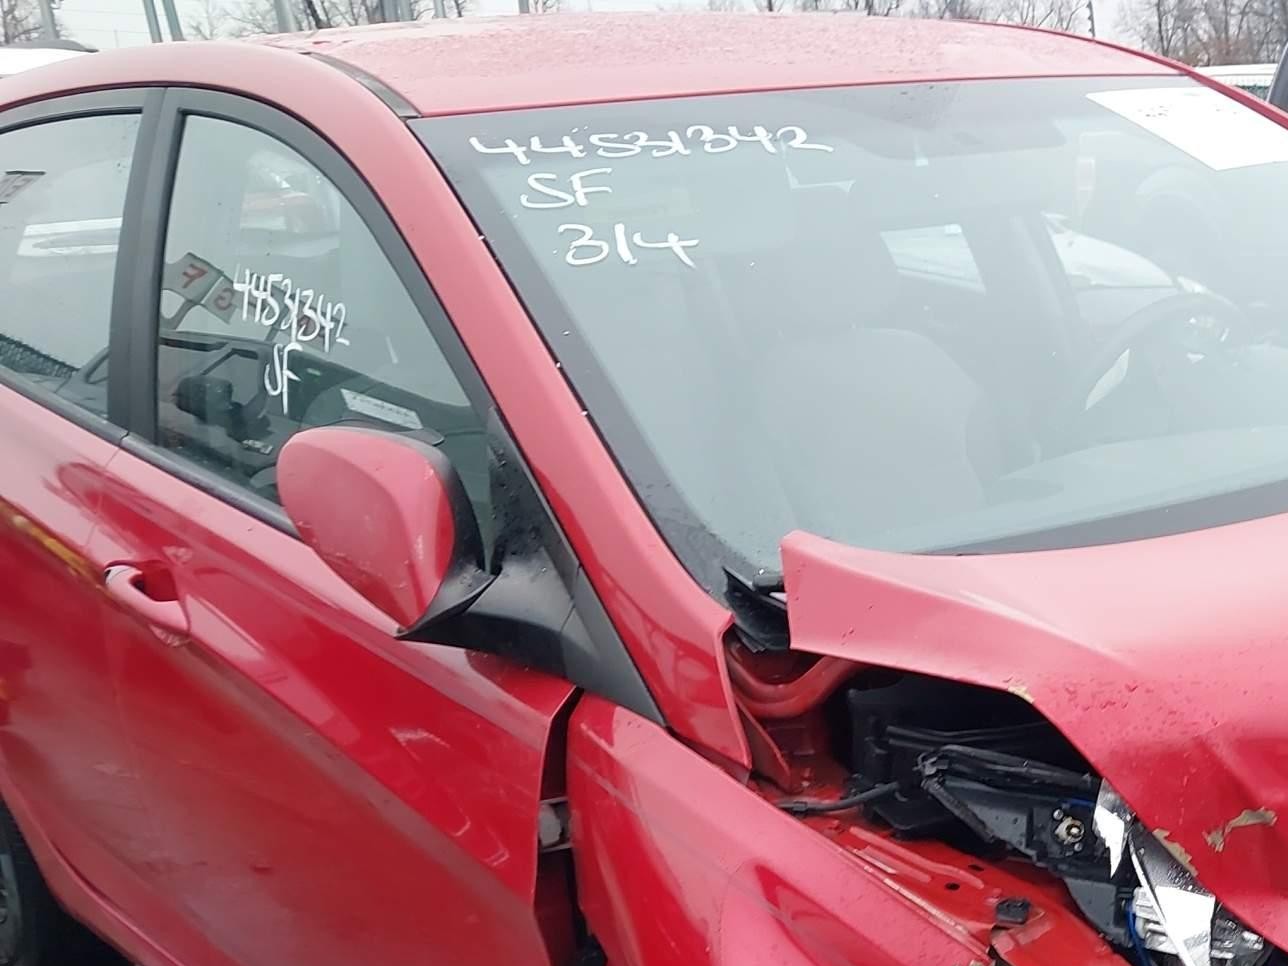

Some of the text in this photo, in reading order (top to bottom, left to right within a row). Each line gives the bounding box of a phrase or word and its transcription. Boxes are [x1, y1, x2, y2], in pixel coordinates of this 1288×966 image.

[469, 125, 834, 165] 44531342
[519, 168, 612, 209] SF
[232, 264, 350, 353] 44531342
[264, 342, 303, 416] SF
